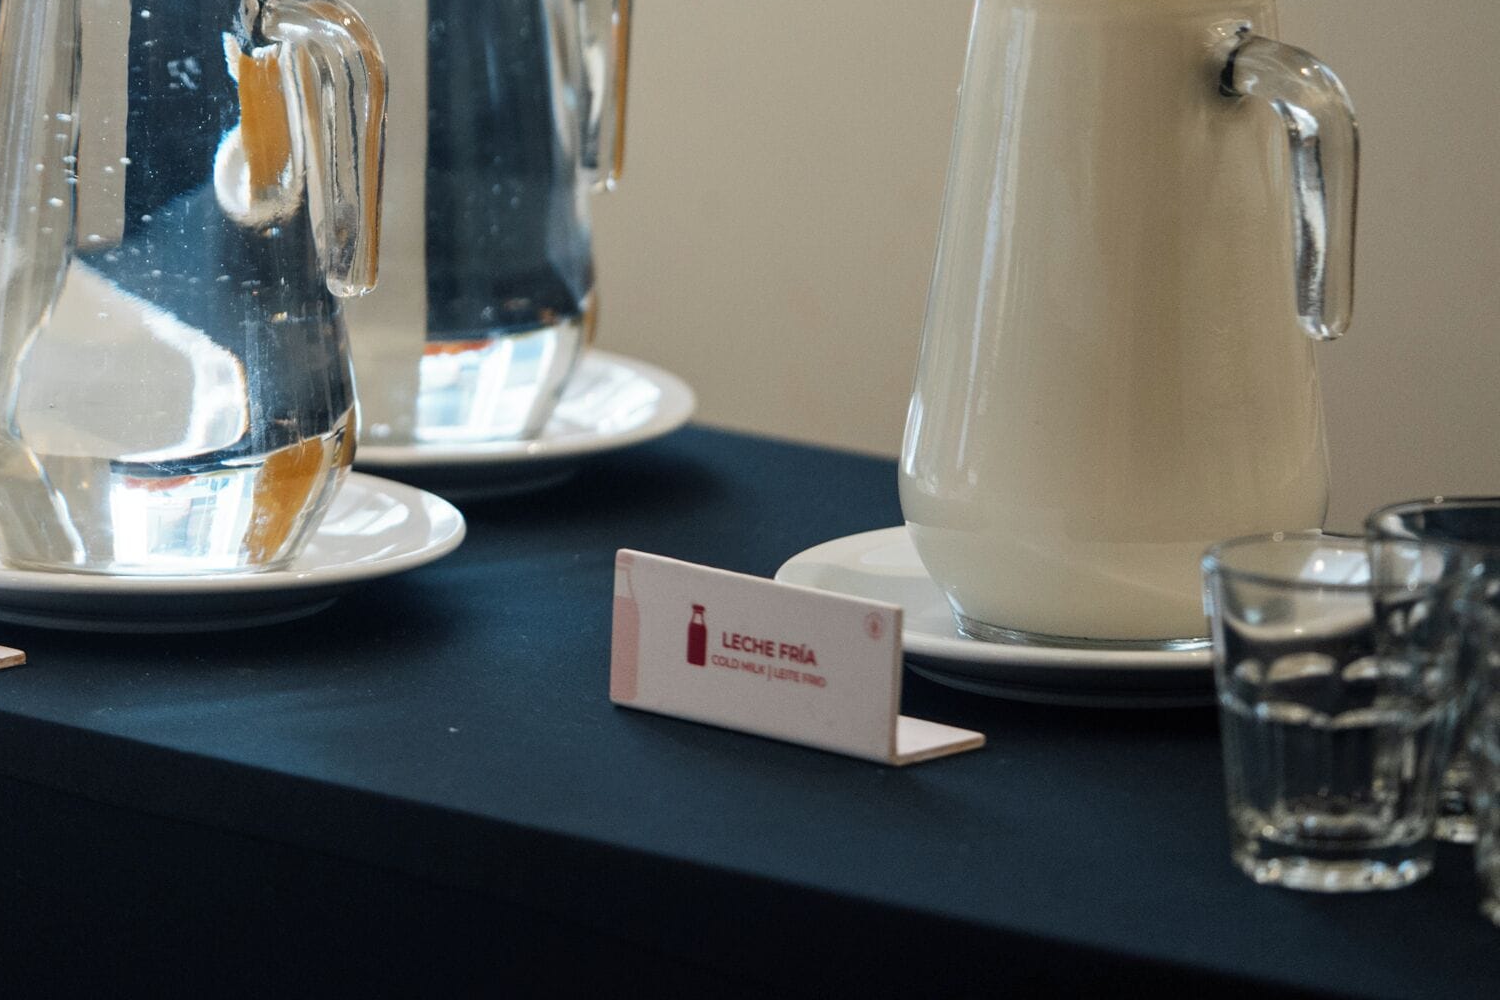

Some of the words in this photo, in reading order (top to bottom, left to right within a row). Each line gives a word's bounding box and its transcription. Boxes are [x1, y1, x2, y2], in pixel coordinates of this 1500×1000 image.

[722, 632, 775, 657] LECHE
[780, 643, 817, 666] FRÍA
[711, 654, 739, 669] COLD
[742, 662, 765, 675] MILK
